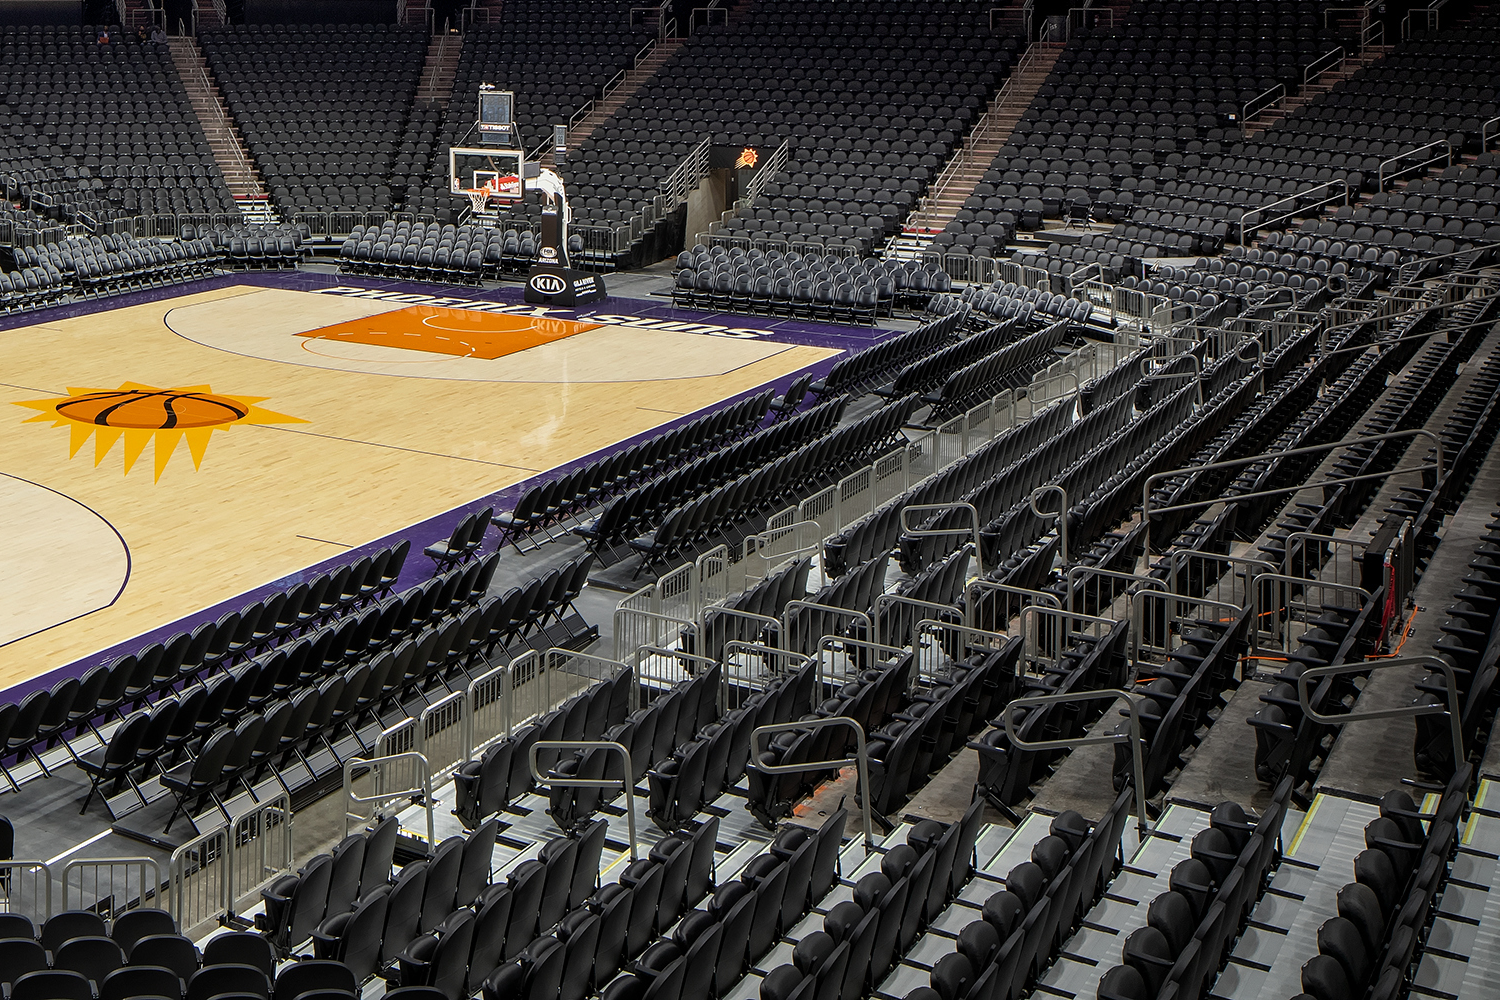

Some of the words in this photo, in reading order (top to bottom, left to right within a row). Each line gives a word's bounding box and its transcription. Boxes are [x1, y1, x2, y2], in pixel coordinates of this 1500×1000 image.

[536, 277, 561, 291] KIA
[308, 286, 575, 318] PHOENIX
[579, 314, 775, 339] SUNS
